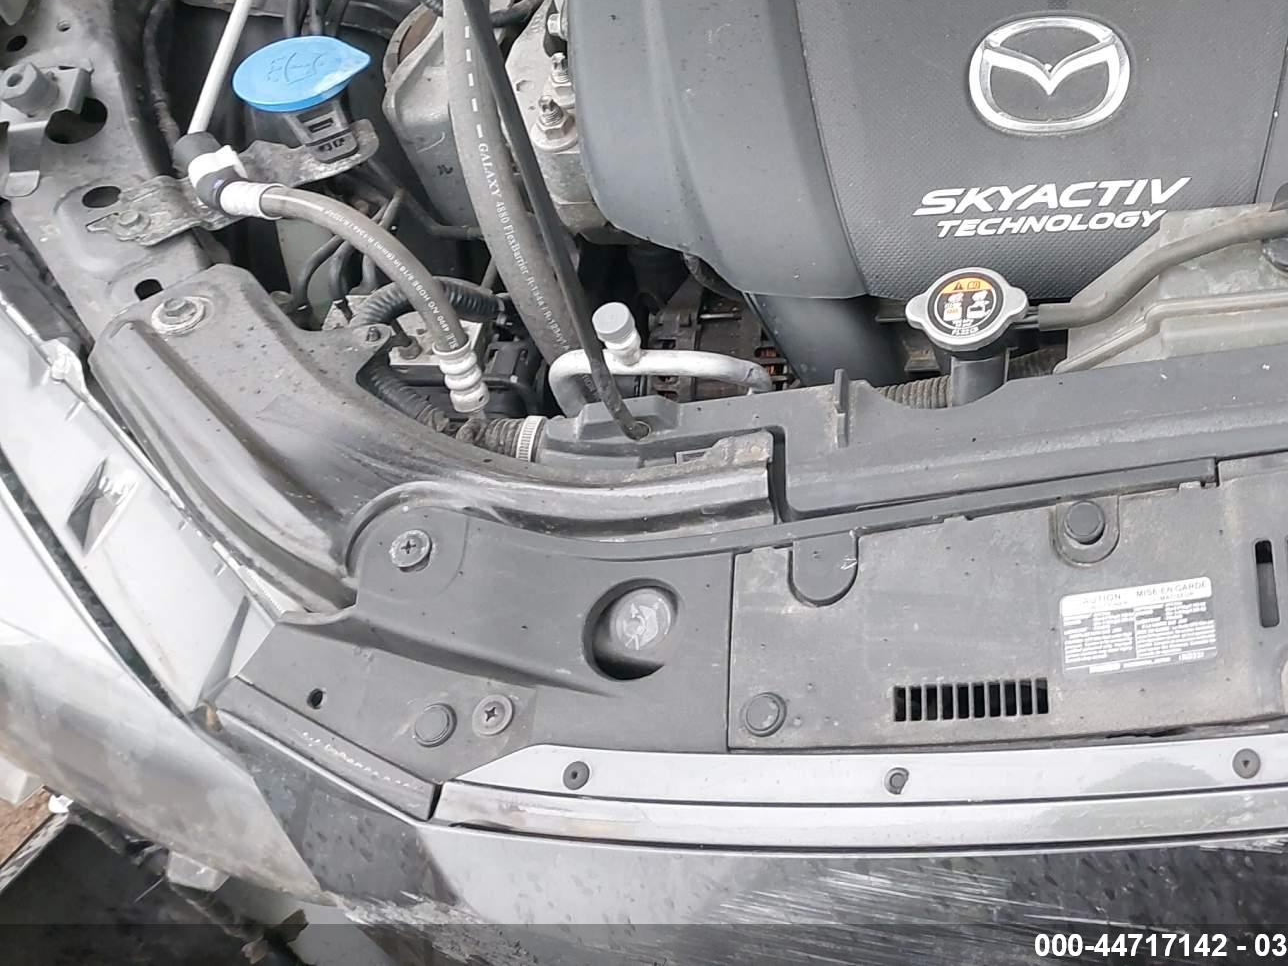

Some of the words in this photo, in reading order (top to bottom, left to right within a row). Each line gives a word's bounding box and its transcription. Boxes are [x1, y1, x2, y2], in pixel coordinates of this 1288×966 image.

[478, 143, 502, 197] GALAXY
[496, 201, 510, 224] 4880
[503, 224, 529, 275] FlexBarrier
[912, 177, 1192, 216] SKYACTIV
[937, 209, 1168, 238] TECHNOLOGY
[412, 280, 432, 302] HOSE
[1173, 580, 1207, 593] GARDE
